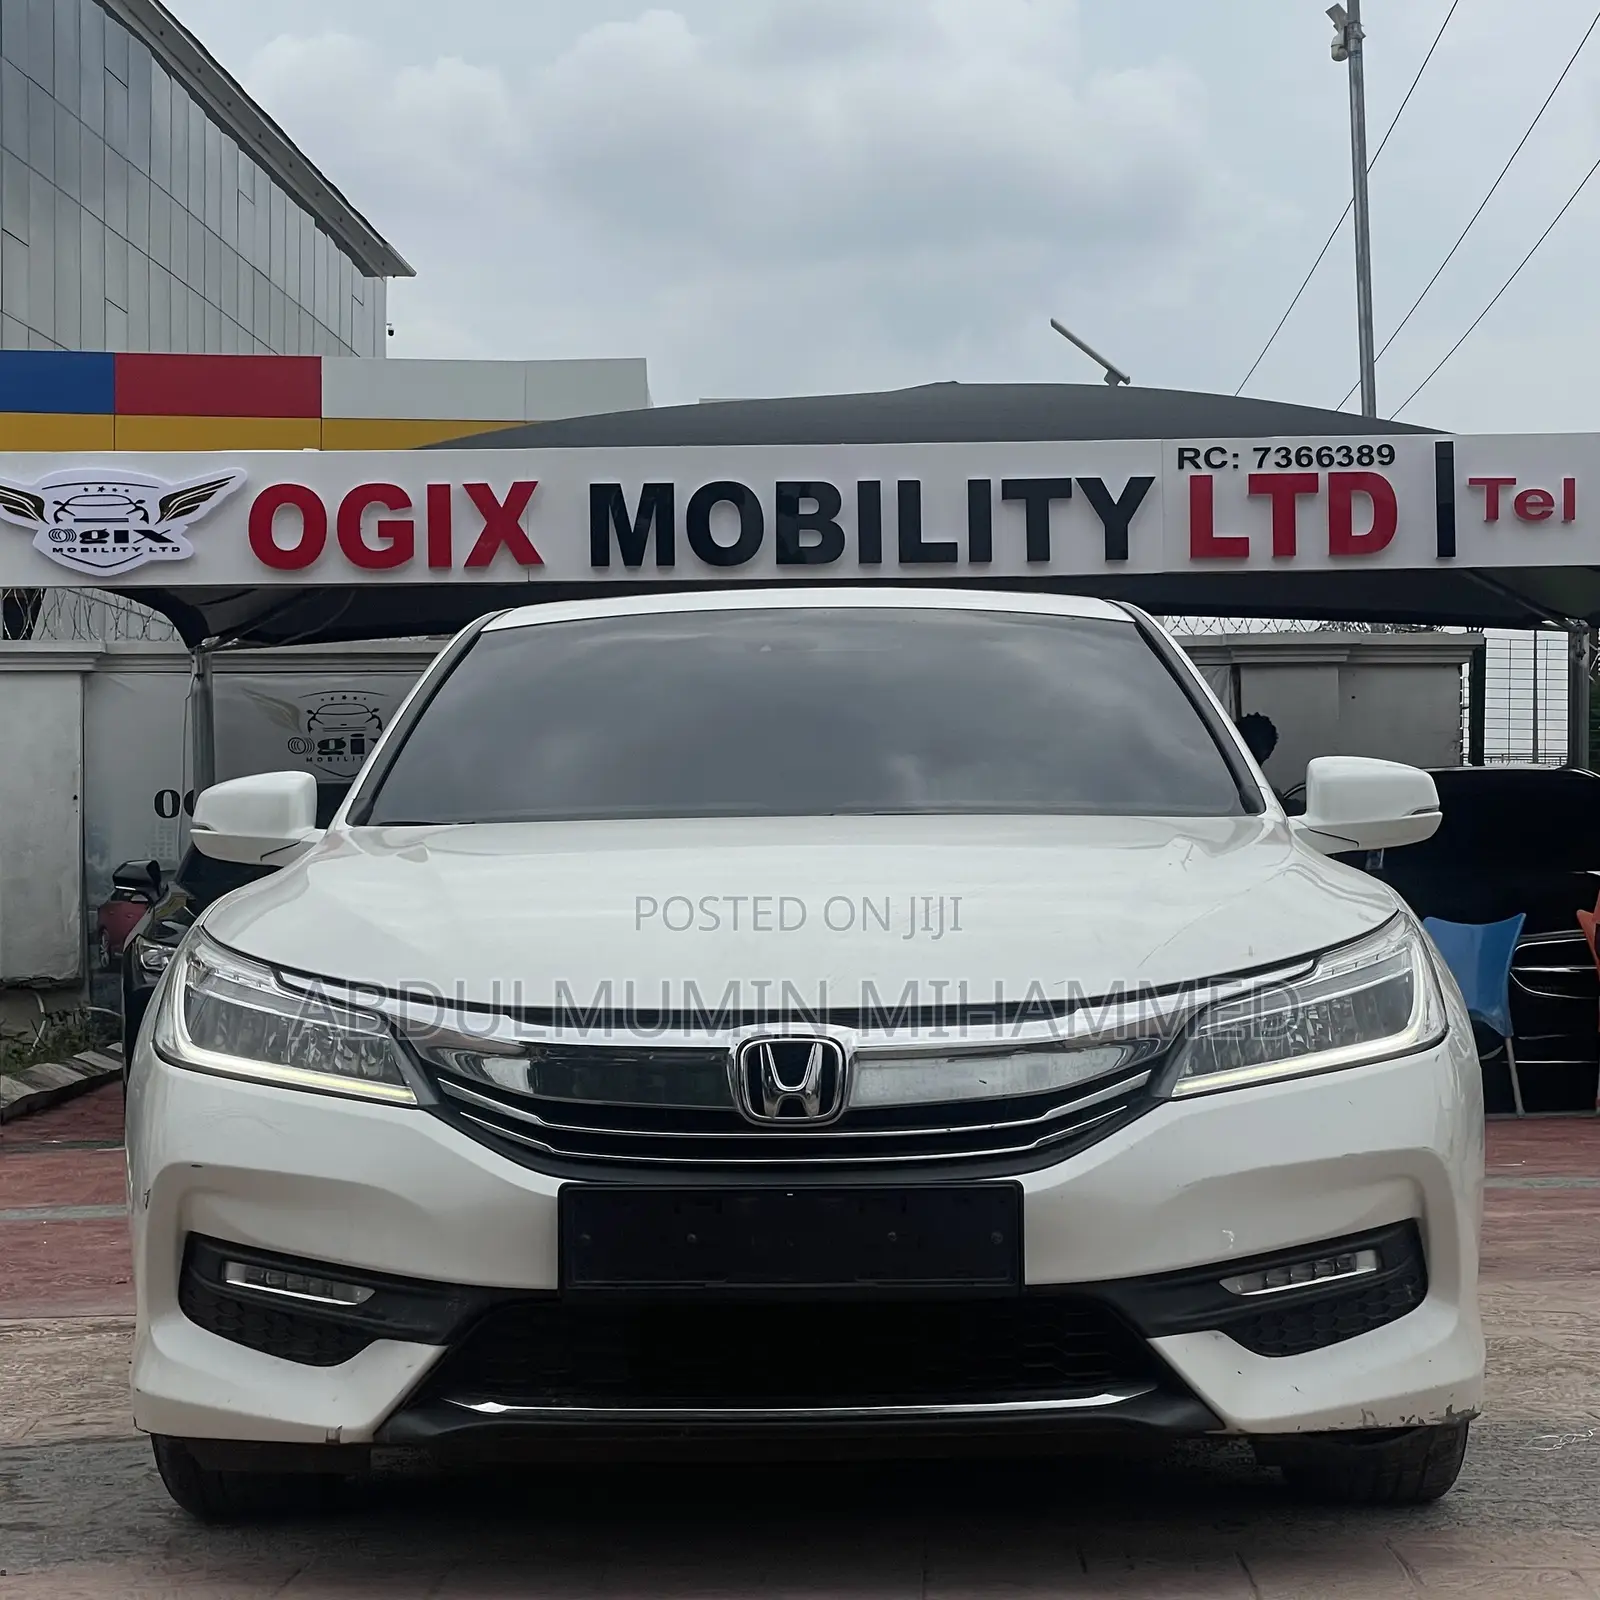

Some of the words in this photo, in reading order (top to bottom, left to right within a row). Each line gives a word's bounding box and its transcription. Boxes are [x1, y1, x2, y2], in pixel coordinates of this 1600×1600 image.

[1177, 447, 1240, 470] RC:
[1252, 444, 1396, 469] 7366389
[248, 481, 545, 569] OGIX
[589, 476, 1156, 567] MOBILITY
[1189, 471, 1399, 559] LTD
[1468, 477, 1577, 523] Tel
